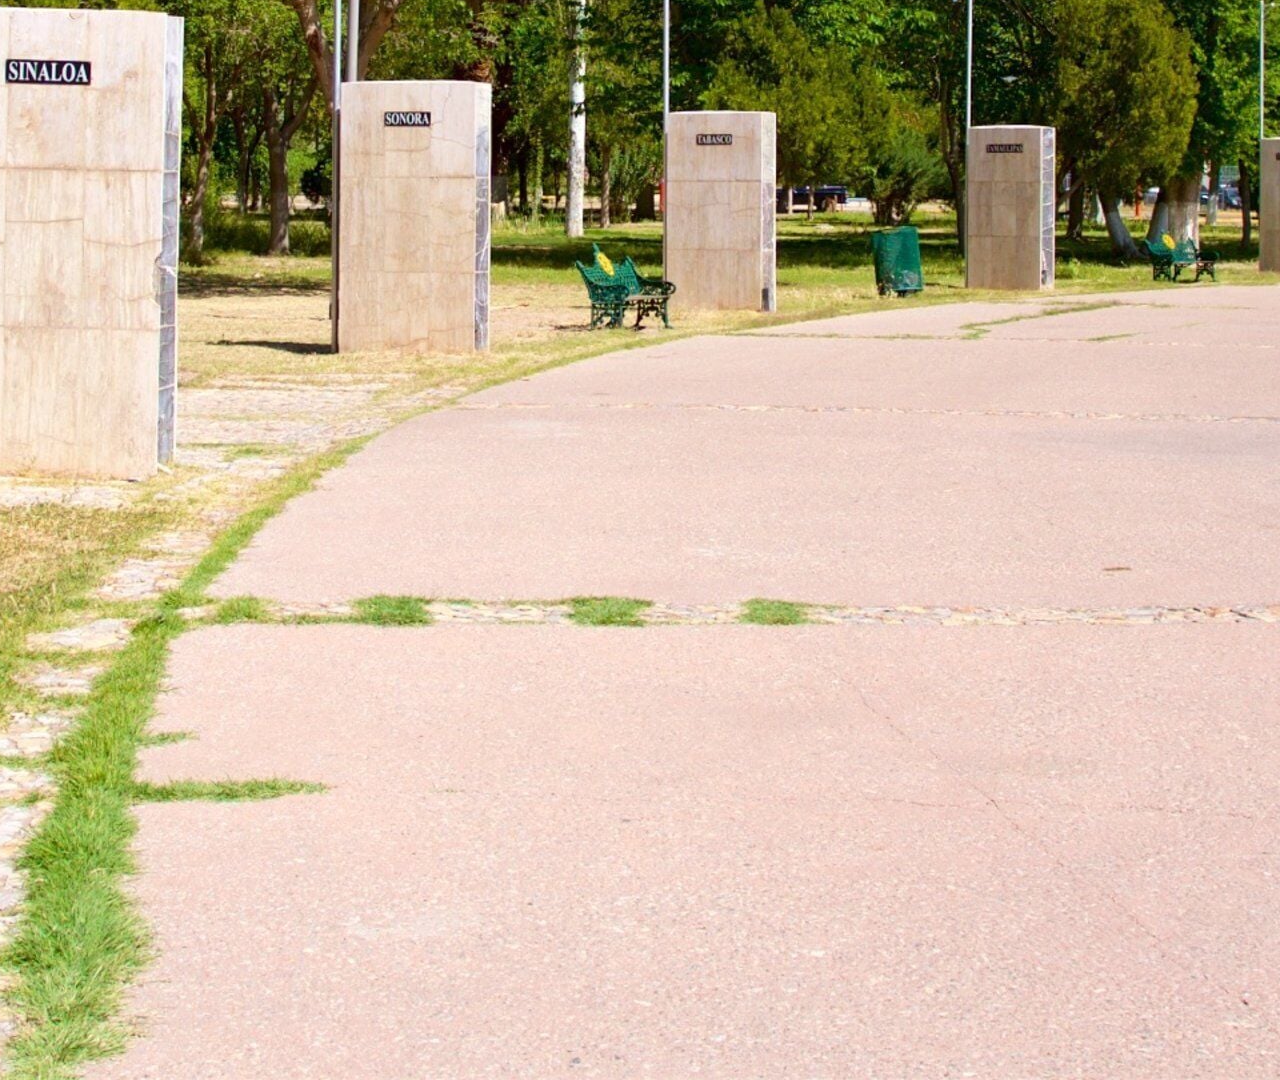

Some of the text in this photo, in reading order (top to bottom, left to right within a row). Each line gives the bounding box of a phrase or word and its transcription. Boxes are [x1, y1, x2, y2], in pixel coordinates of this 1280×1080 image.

[8, 61, 88, 82] SINALOA
[385, 113, 429, 125] SONORA
[697, 135, 731, 144] TABASCO
